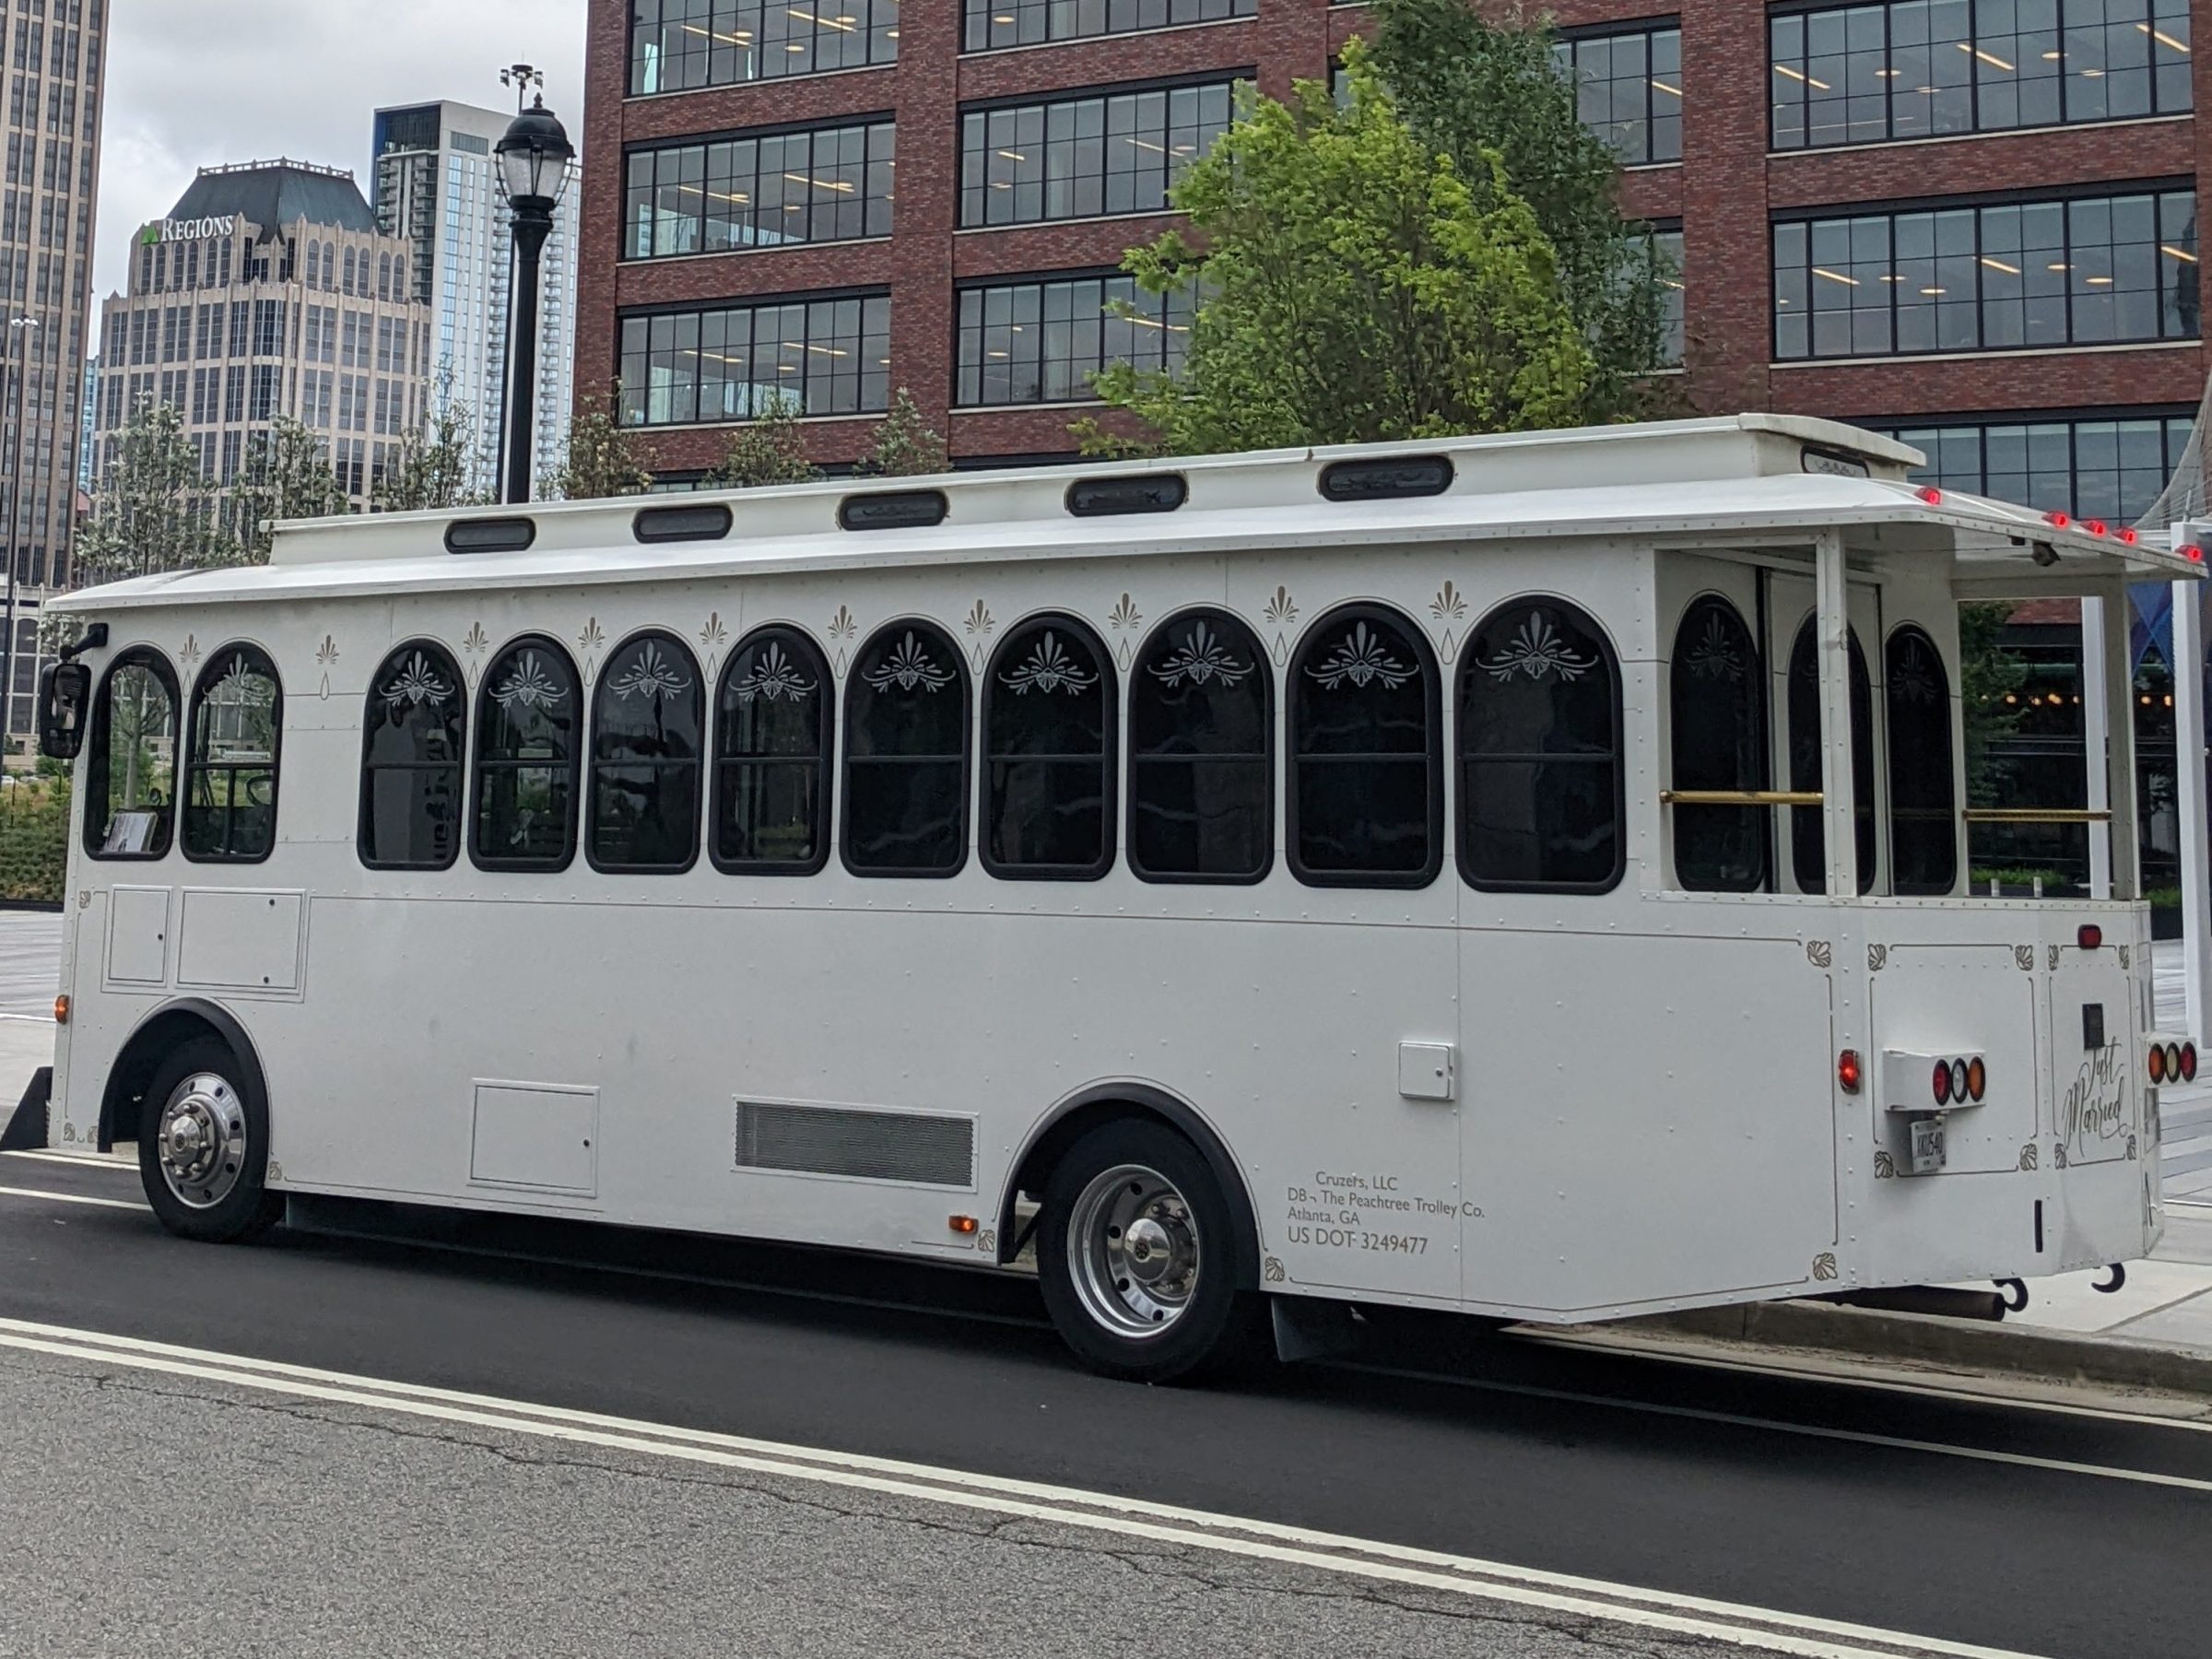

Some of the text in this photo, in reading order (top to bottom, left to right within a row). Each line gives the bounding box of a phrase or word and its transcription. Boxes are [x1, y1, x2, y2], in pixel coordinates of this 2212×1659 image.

[160, 215, 234, 242] REGIONS
[2061, 1076, 2129, 1159] Married
[1315, 1171, 1398, 1192] Cruzers, LLC
[1321, 1189, 1345, 1206] The
[1348, 1192, 1410, 1212] Peachtree
[1414, 1197, 1458, 1219] Trolley
[1462, 1201, 1486, 1218] Co.
[1339, 1209, 1360, 1226] GA
[1288, 1226, 1311, 1244] US
[1360, 1231, 1429, 1254] 3249477
